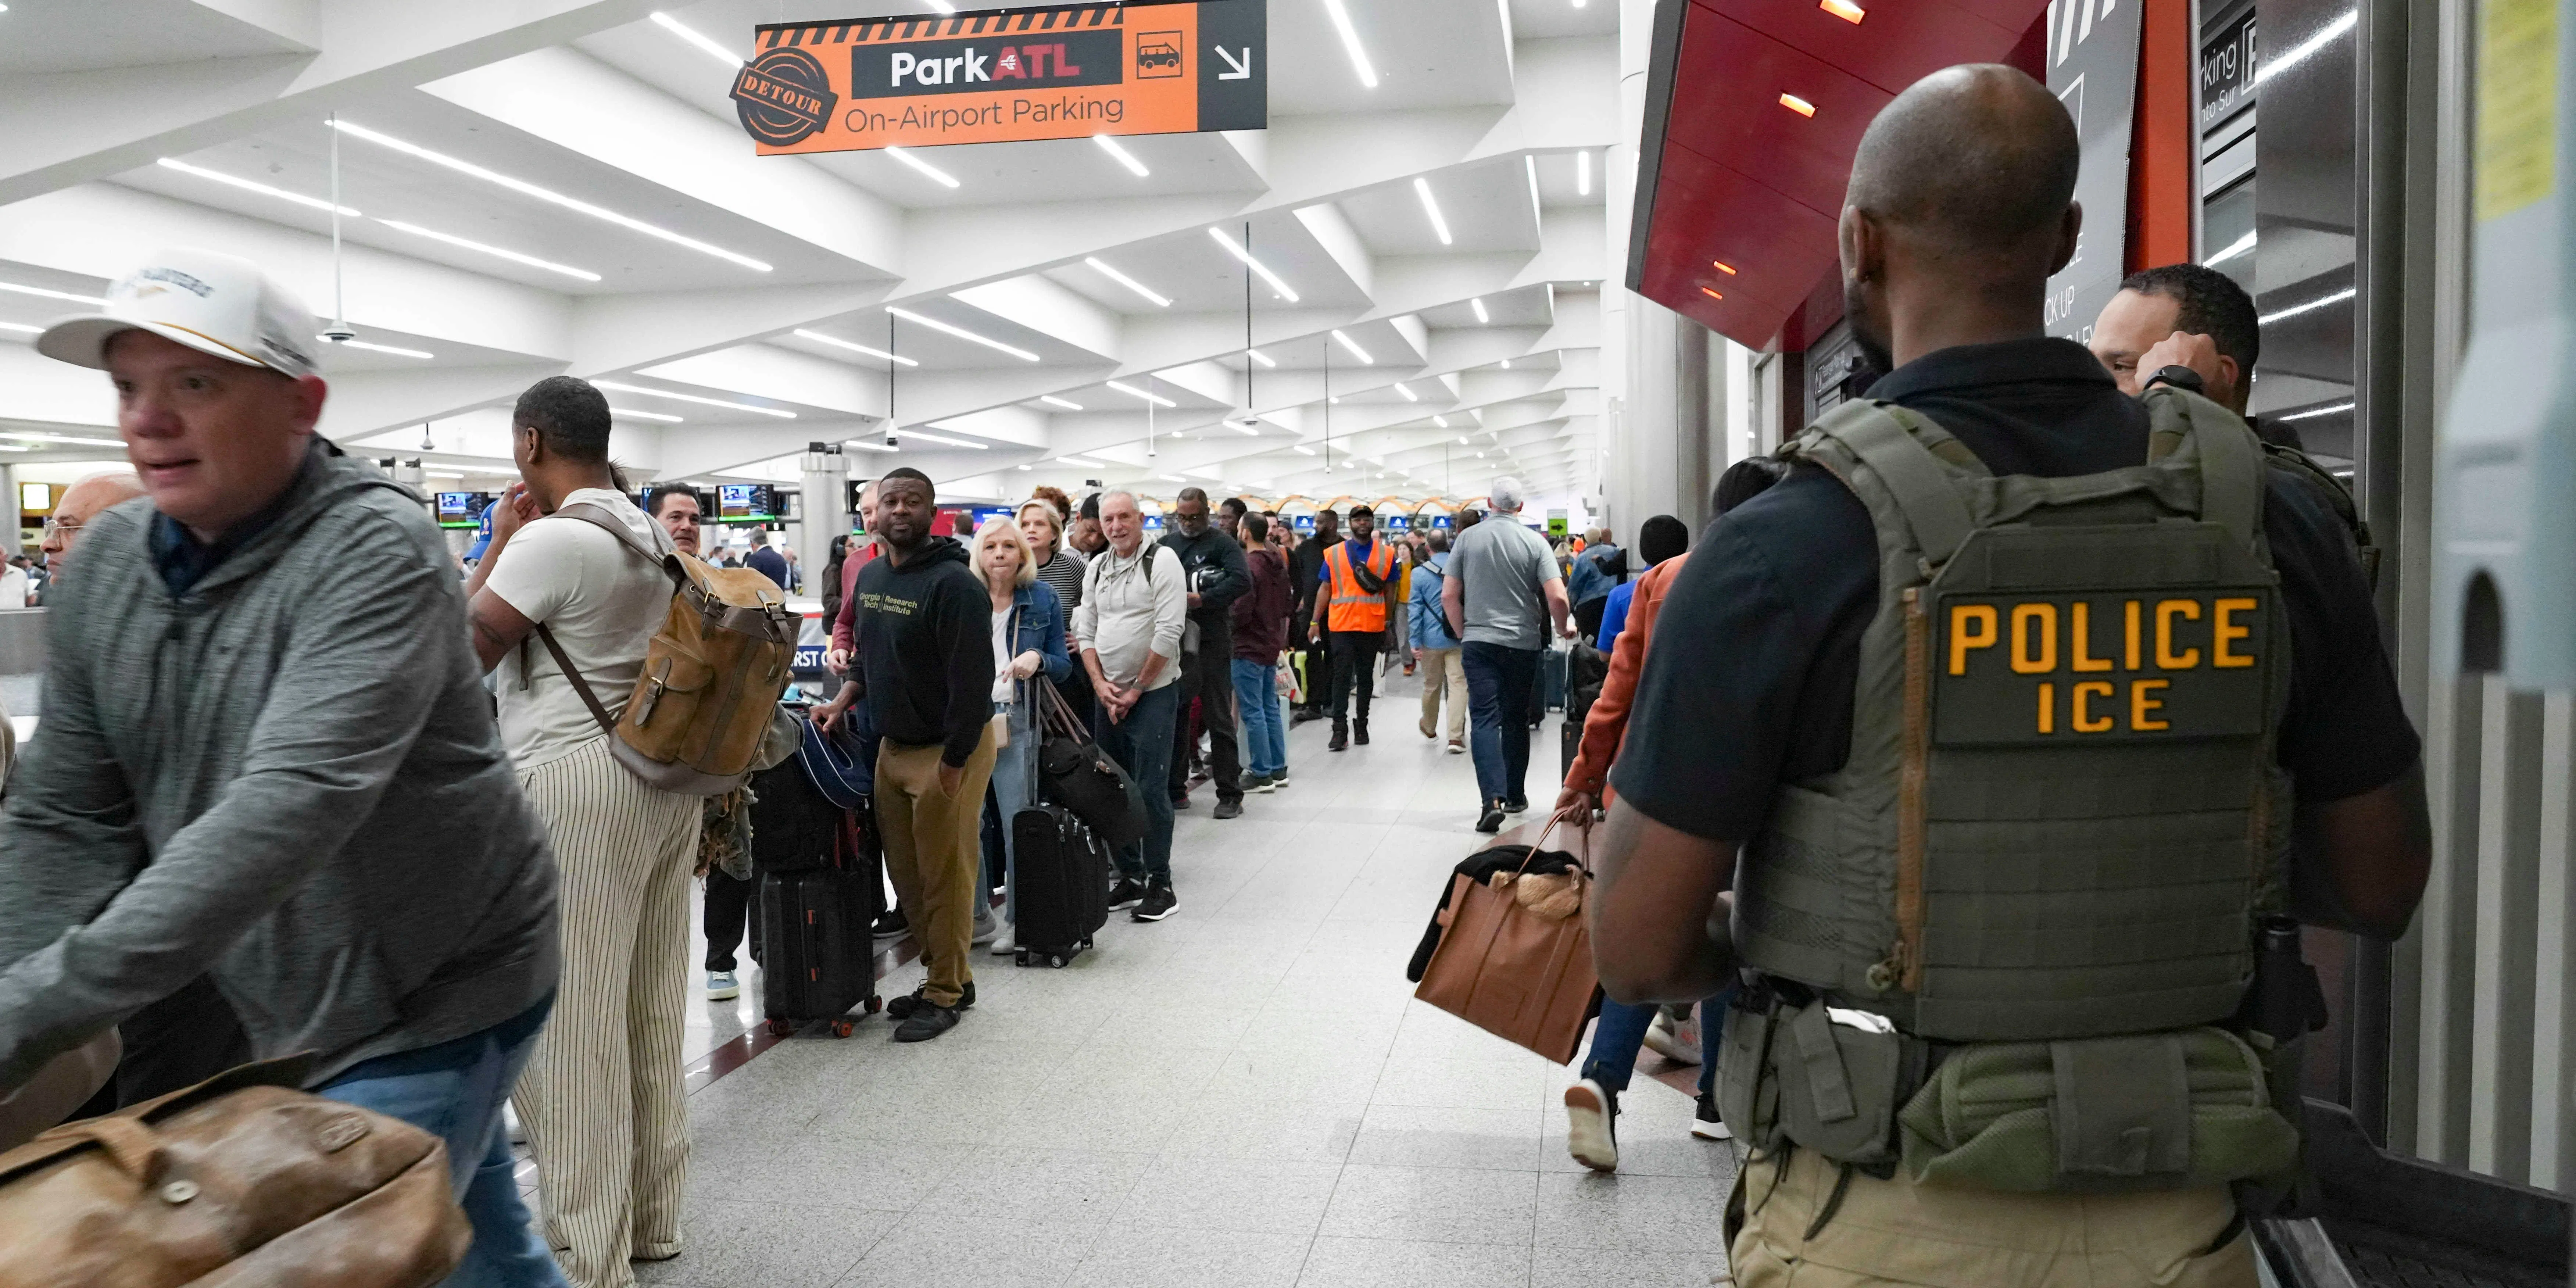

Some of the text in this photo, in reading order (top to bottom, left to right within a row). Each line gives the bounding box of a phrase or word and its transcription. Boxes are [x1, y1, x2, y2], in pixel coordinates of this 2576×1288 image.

[891, 43, 1081, 87] ParkATL
[744, 75, 822, 115] DETOUR
[2219, 85, 2236, 111] Sur
[845, 95, 1123, 133] On-Airport Parking
[2060, 285, 2074, 318] UP
[859, 592, 880, 602] Georgia
[864, 600, 878, 609] Tech
[883, 603, 911, 616] Institute
[885, 595, 917, 609] Research
[1949, 598, 2258, 676] POLICE
[791, 650, 819, 667] RST
[2037, 679, 2170, 734] ICE
